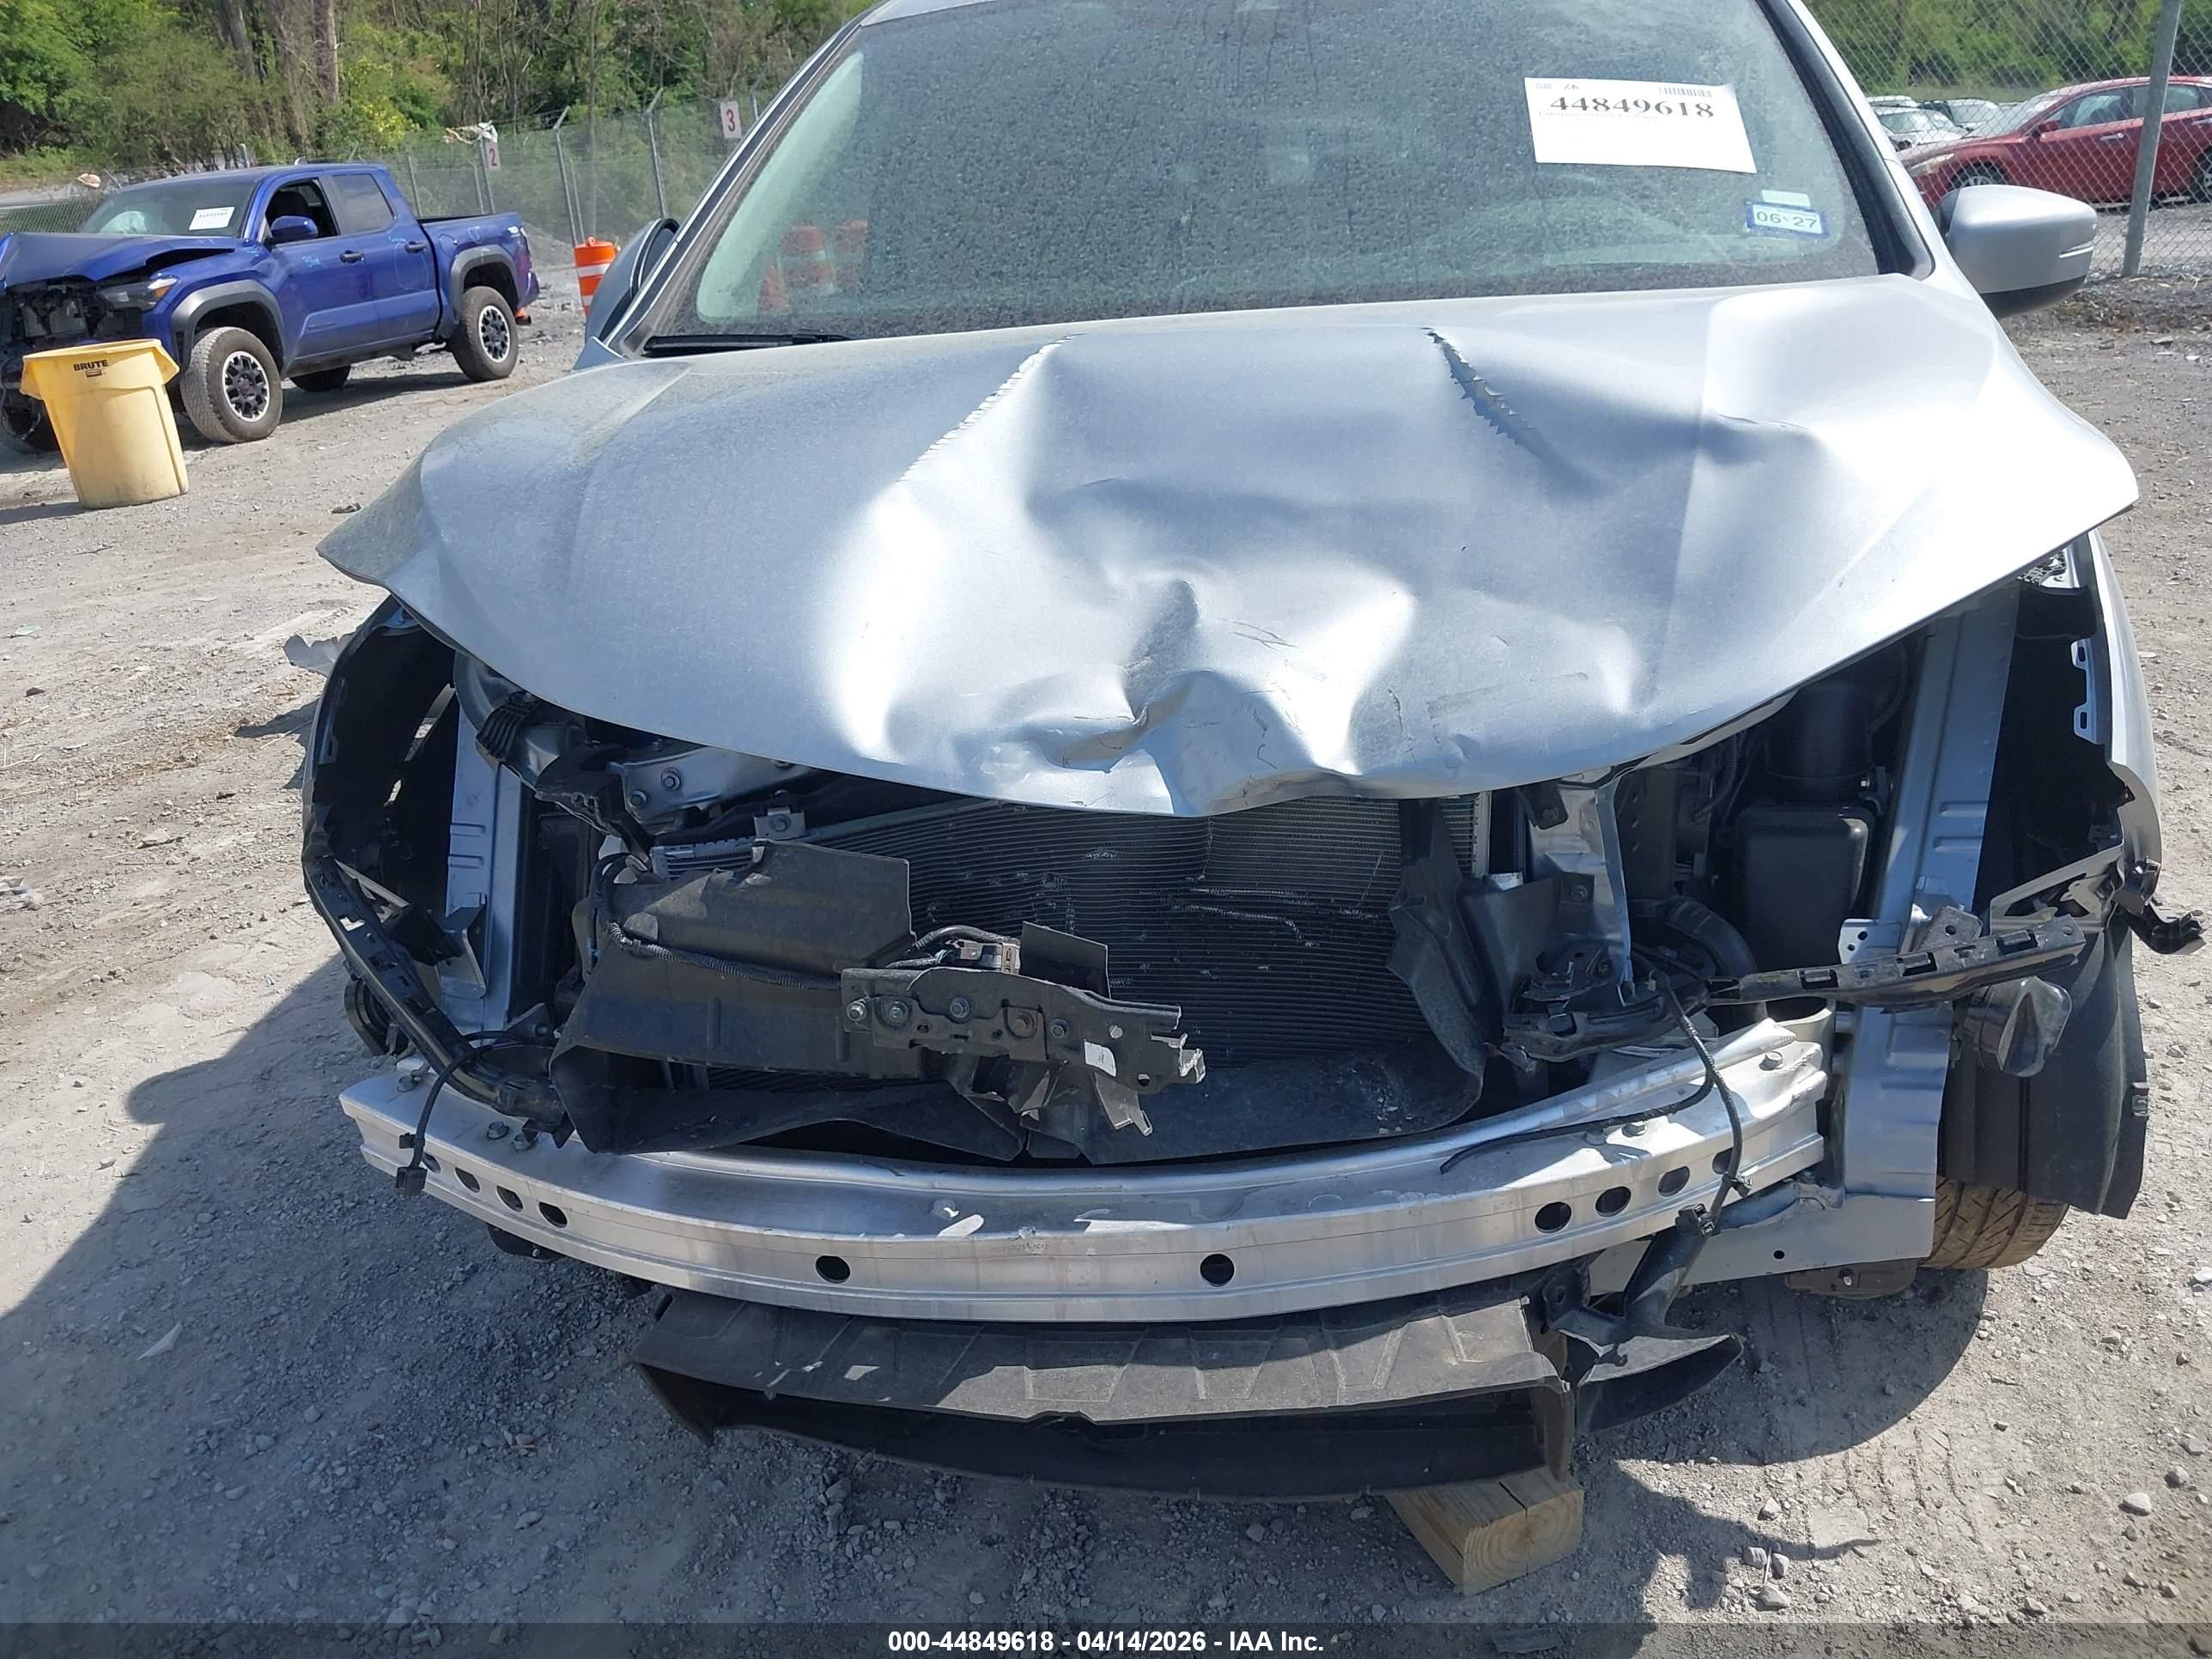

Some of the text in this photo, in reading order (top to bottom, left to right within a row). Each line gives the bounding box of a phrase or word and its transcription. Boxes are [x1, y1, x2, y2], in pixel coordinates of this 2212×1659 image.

[1550, 96, 1714, 118] 44849618
[726, 109, 735, 131] 3
[489, 148, 497, 167] 2
[73, 359, 109, 371] BRUTE
